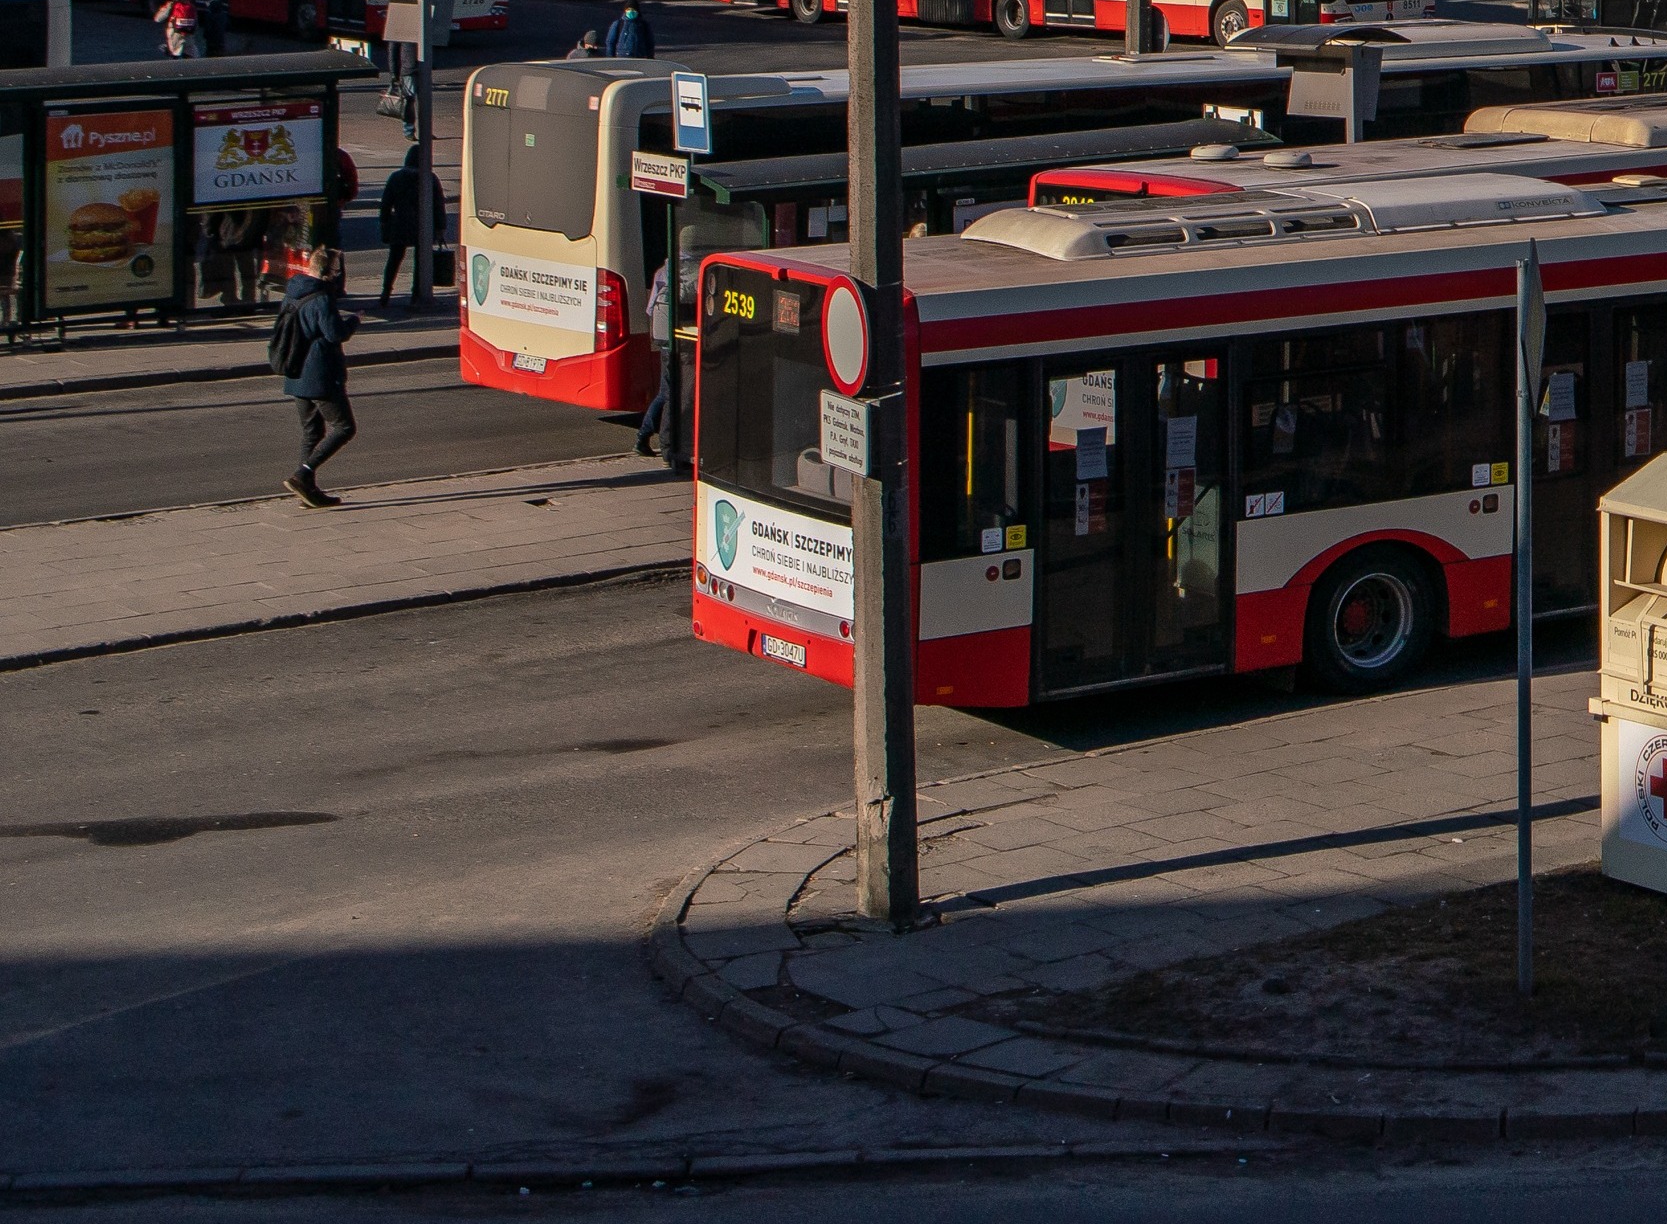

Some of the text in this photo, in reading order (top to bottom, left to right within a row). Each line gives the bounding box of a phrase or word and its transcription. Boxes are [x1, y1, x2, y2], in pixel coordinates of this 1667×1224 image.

[1402, 0, 1421, 10] 8511
[485, 87, 510, 107] 2777
[88, 128, 156, 149] Pyszne.pl
[214, 167, 300, 189] GDAŃSK
[634, 158, 687, 180] Wrzeszcz PKP
[1511, 197, 1571, 210] KONVEKTA
[500, 265, 588, 296] GDAŃSK SZCZEPIMY SIĘ
[724, 290, 756, 319] 2539
[752, 520, 853, 564] GDAŃSK SZCZEPIMY
[751, 545, 776, 565] CHROŃ
[776, 556, 801, 577] SIEBIE
[806, 564, 855, 586] NAJBLIŻSZY
[752, 565, 834, 599] www.gdansk.pl/szczepienia
[1614, 626, 1631, 639] Pomóż
[767, 637, 804, 663] GD 3047U
[1637, 770, 1660, 831] POLSKI
